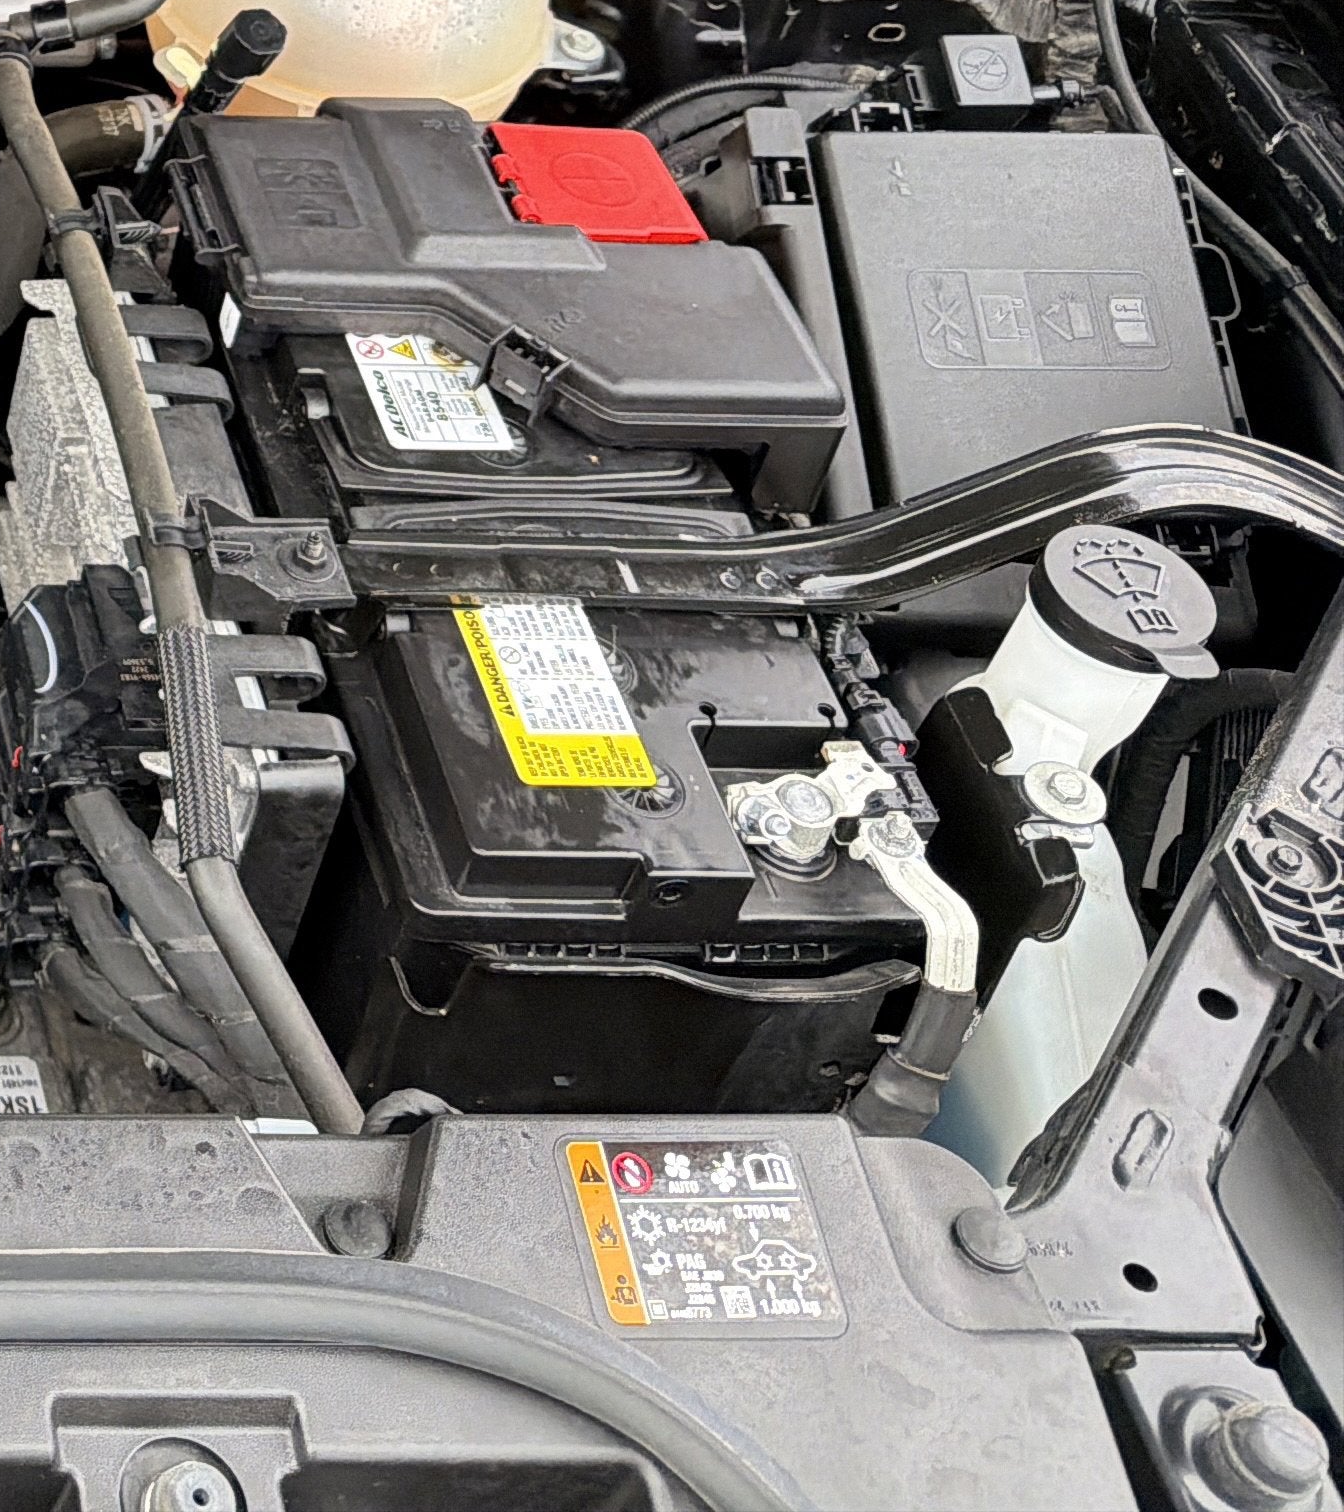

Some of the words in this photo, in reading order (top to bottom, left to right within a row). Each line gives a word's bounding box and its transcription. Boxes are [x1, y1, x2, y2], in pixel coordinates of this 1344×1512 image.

[373, 370, 409, 438] ACDelco
[427, 391, 448, 421] 8540
[463, 609, 509, 704] DANGER/POISO
[668, 1181, 700, 1194] AUTO
[732, 1204, 770, 1220] 0.700
[770, 1204, 791, 1223] kg
[666, 1217, 726, 1235] R-1234yf
[675, 1252, 707, 1270] PAG
[801, 1299, 822, 1318] kg
